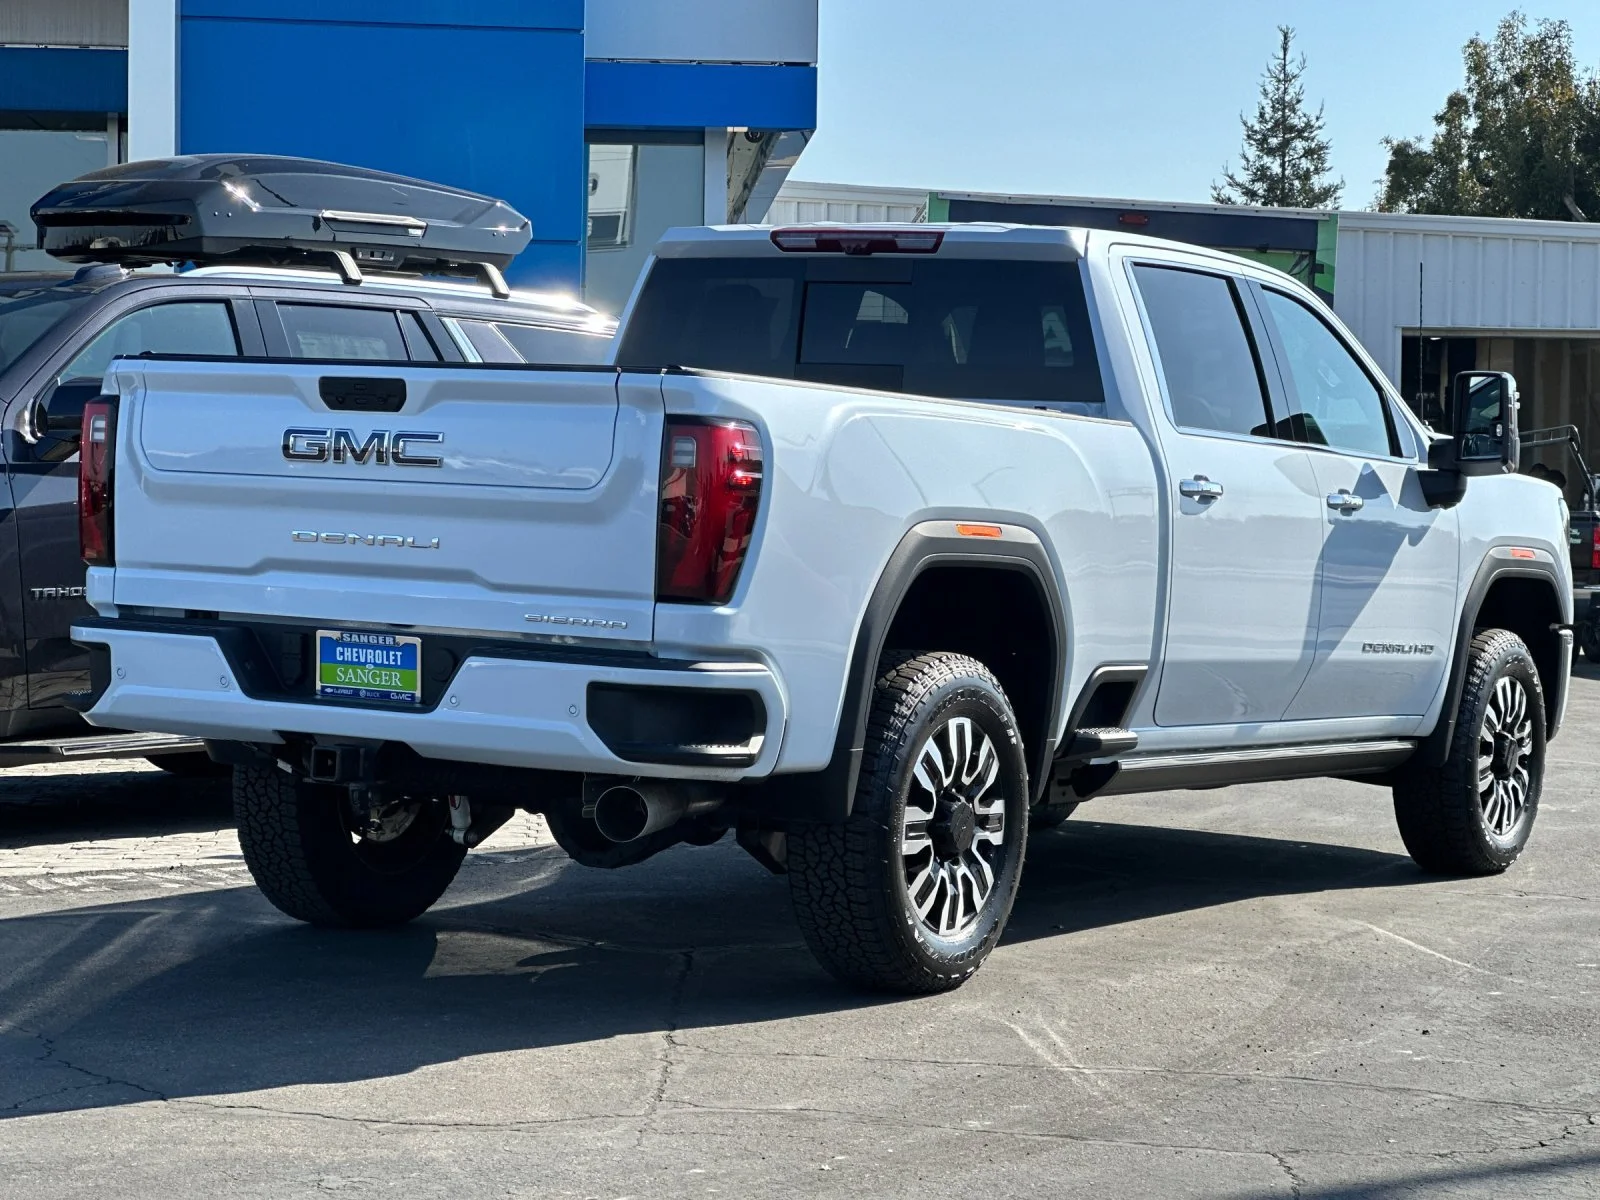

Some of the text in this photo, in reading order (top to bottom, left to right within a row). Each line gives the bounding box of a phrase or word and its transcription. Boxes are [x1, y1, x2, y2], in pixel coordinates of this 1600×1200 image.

[281, 426, 445, 468] GMC
[291, 530, 440, 549] DENALI
[524, 613, 628, 630] SIERRA
[342, 633, 394, 645] SANGER
[336, 646, 402, 665] CHEVROLET
[336, 667, 402, 686] SANGER
[390, 692, 412, 701] GMC
